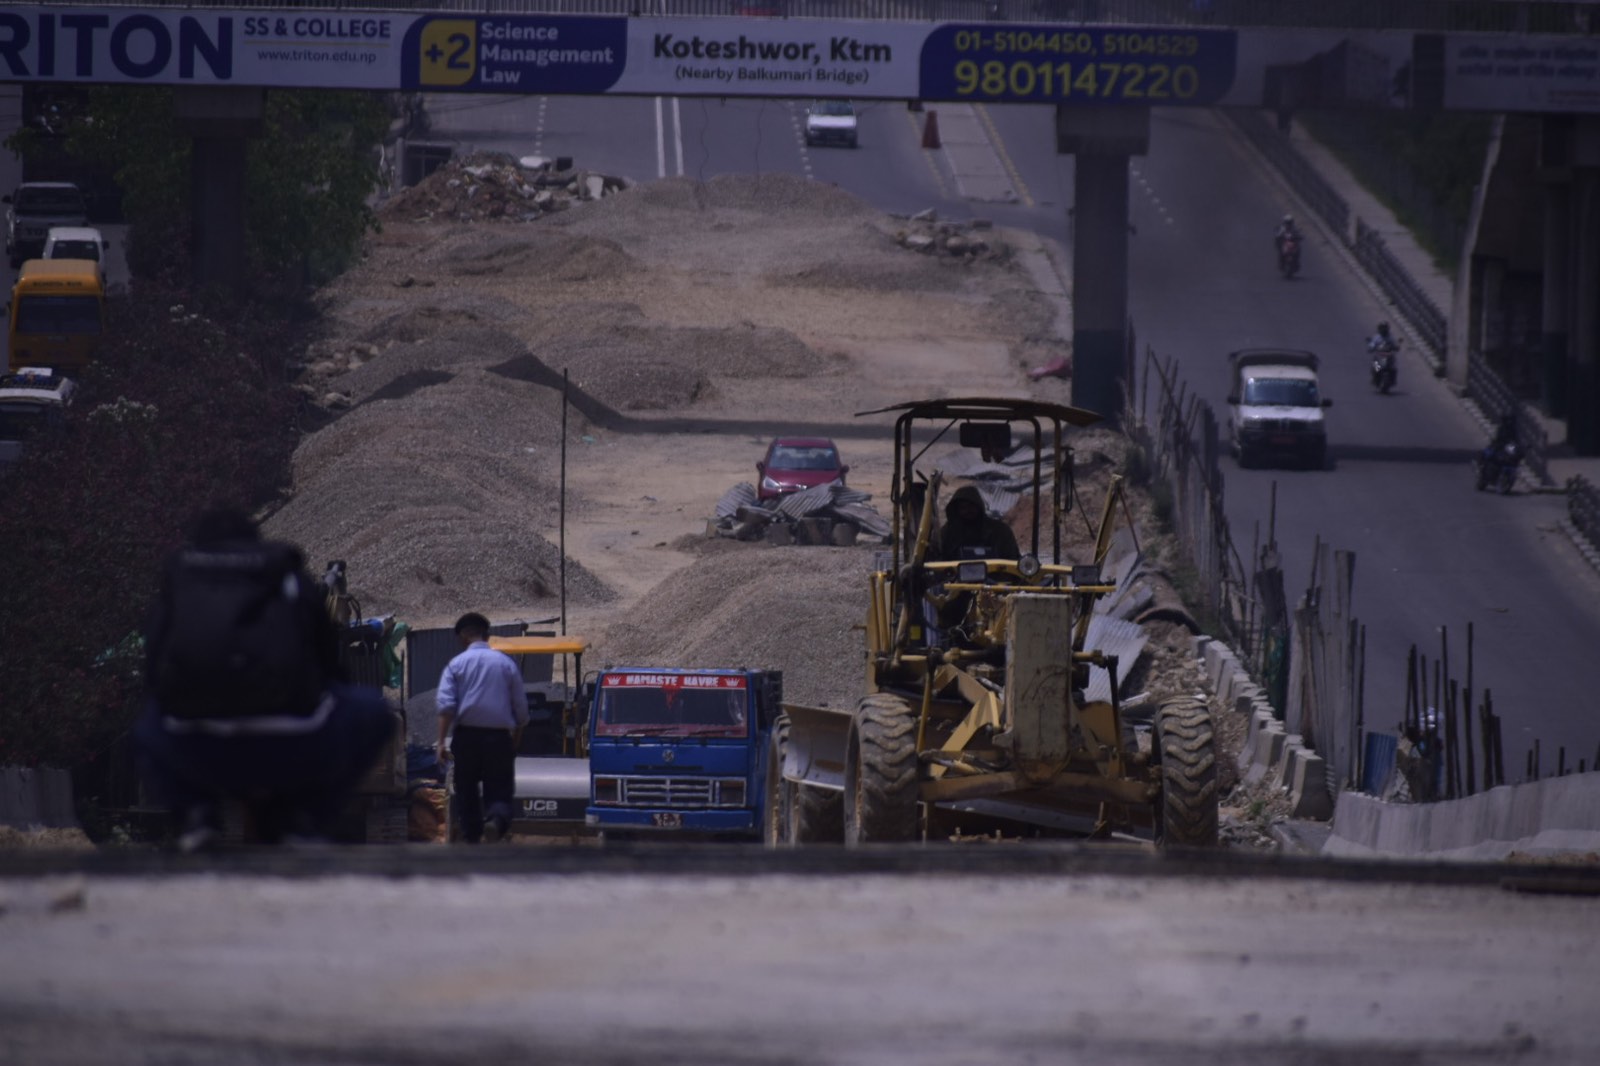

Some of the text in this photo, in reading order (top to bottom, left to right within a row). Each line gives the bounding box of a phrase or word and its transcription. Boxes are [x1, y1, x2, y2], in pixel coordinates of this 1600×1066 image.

[243, 17, 391, 39] SS & COLLEGE
[481, 22, 559, 41] Science
[425, 32, 471, 70] +2
[654, 33, 892, 65] Koteshwor, Ktm
[954, 31, 1199, 56] 01-5104450, 5104529
[257, 48, 377, 64] www.triton.edu.np
[481, 44, 614, 66] Management
[481, 66, 521, 83] Law
[675, 65, 869, 84] (Nearby Balkumari Bridge)
[954, 60, 1199, 97] 9801147220
[626, 675, 678, 687] NAMASTE
[523, 800, 558, 811] JCB
